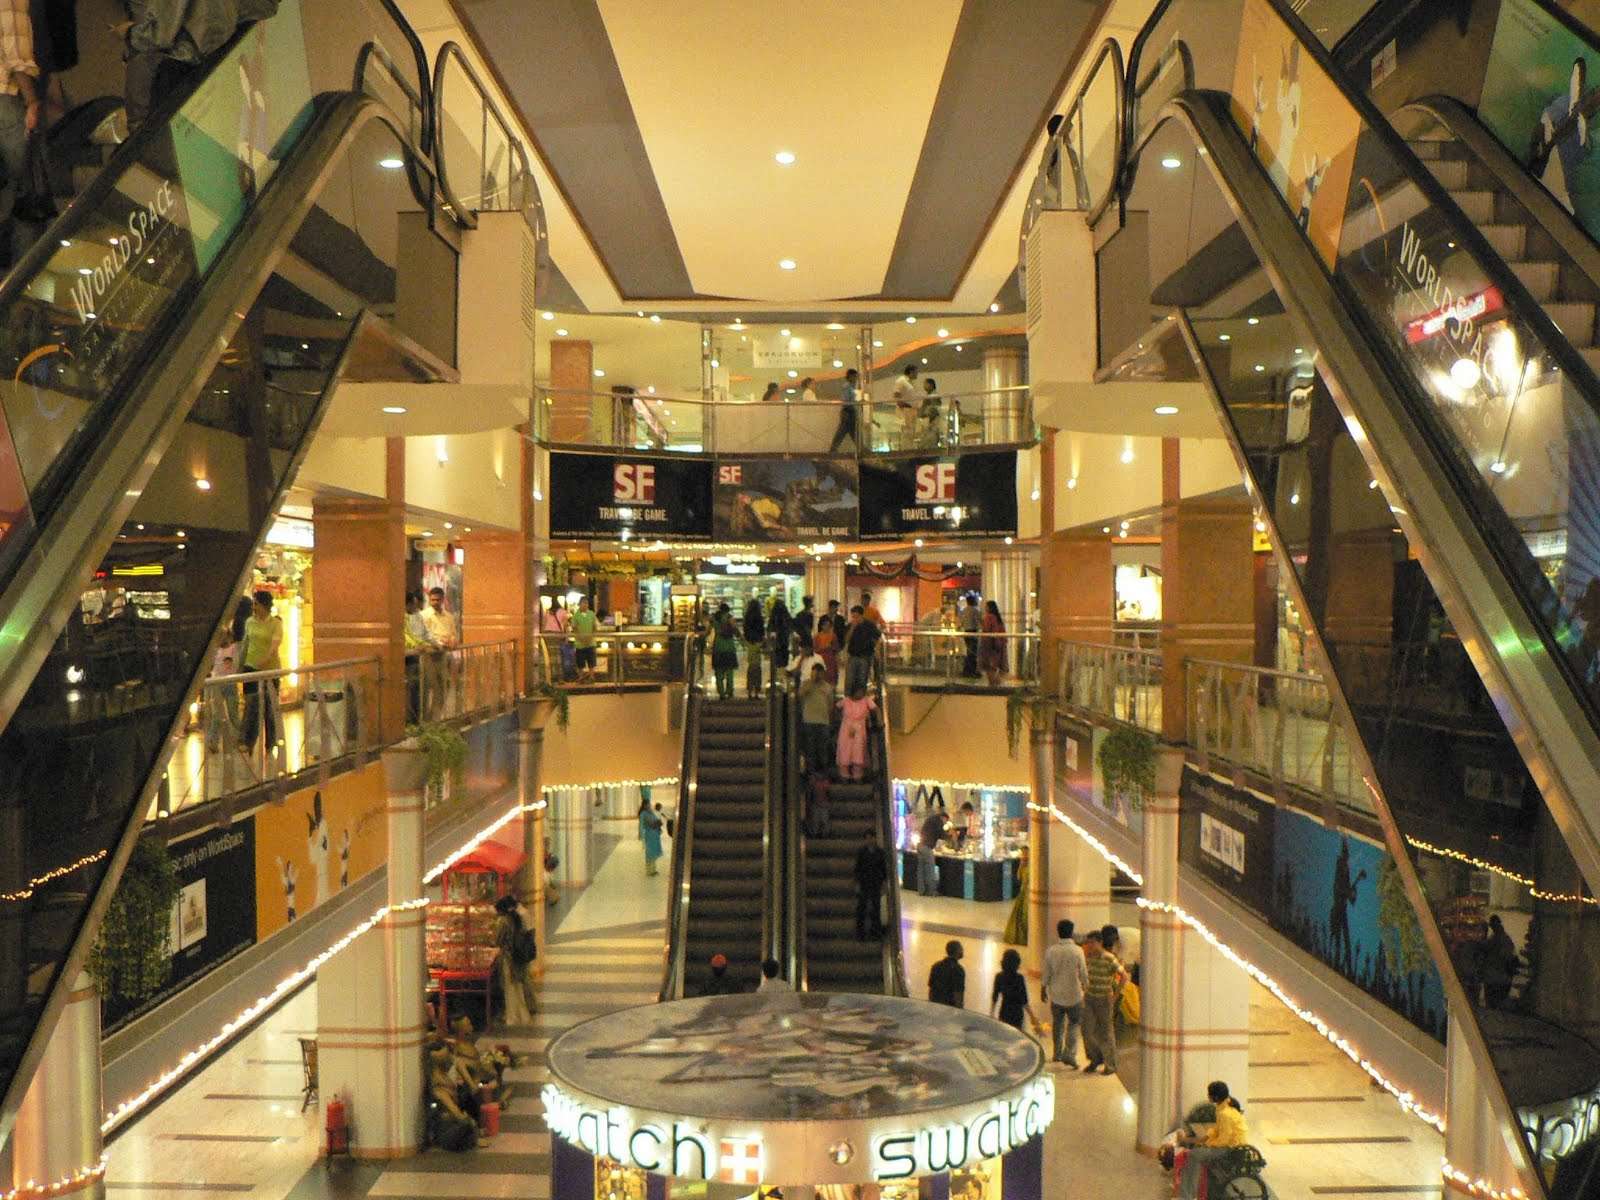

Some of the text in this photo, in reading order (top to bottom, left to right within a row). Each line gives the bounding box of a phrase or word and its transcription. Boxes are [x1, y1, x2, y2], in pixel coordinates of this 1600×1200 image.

[615, 464, 655, 500] SF
[719, 466, 741, 481] SF
[916, 463, 955, 500] SF
